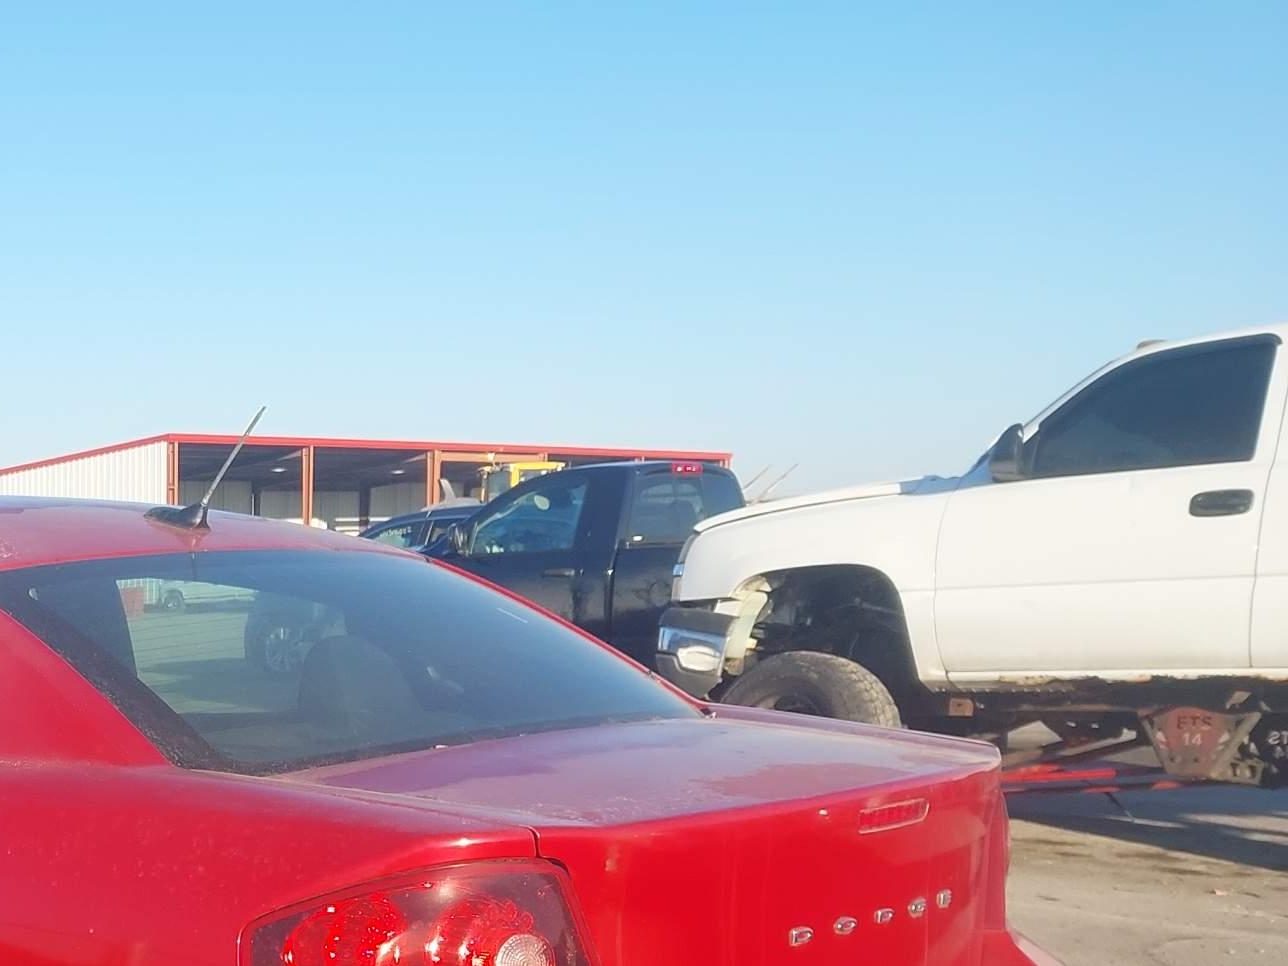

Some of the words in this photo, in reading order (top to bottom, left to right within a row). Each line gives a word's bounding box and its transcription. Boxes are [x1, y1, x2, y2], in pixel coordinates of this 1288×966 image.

[1177, 715, 1213, 730] ETS
[1182, 732, 1203, 746] 14
[789, 889, 952, 947] DODGE
